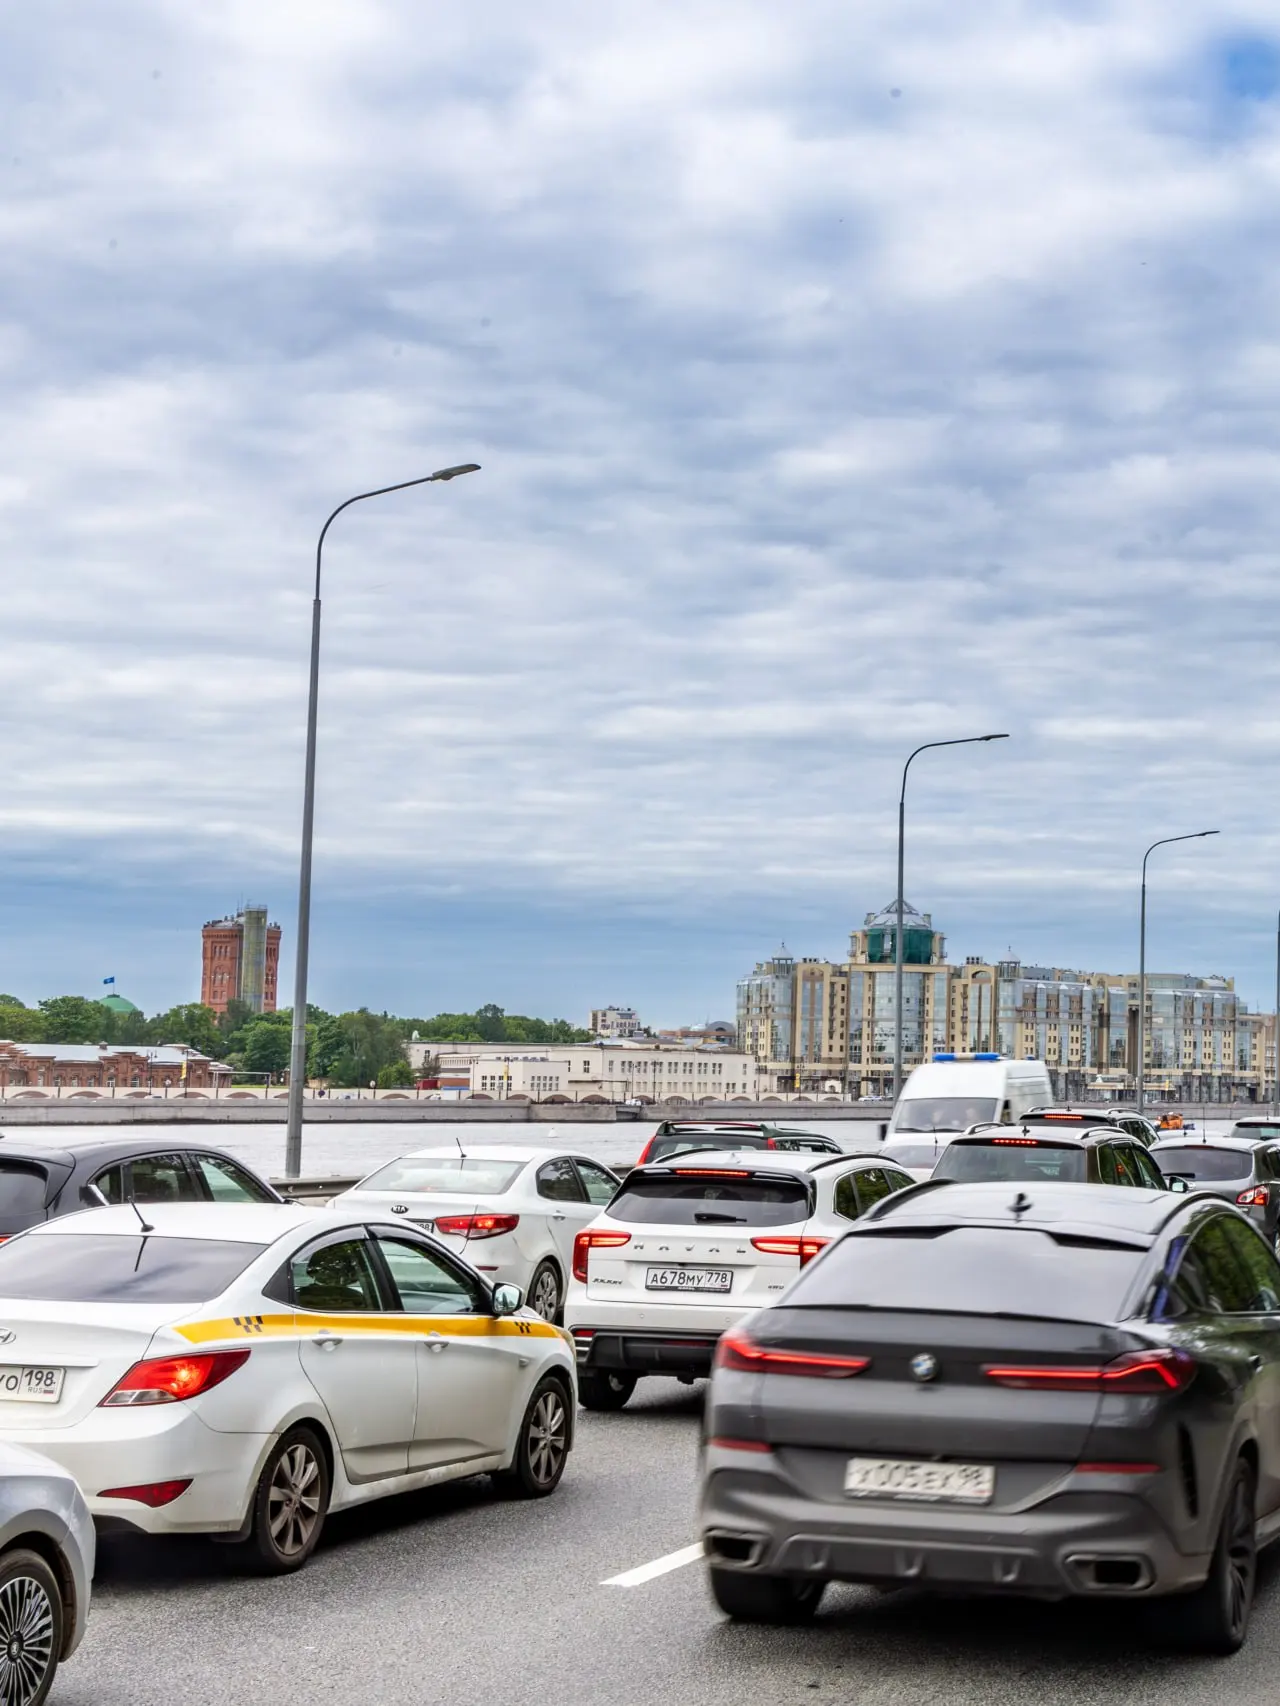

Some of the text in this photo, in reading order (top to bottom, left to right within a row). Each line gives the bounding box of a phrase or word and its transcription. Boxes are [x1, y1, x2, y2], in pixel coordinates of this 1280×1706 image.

[392, 1205, 407, 1213] KIA
[650, 1270, 728, 1286] А678МУ 778
[24, 1369, 55, 1387] 198
[27, 1386, 43, 1394] RUS
